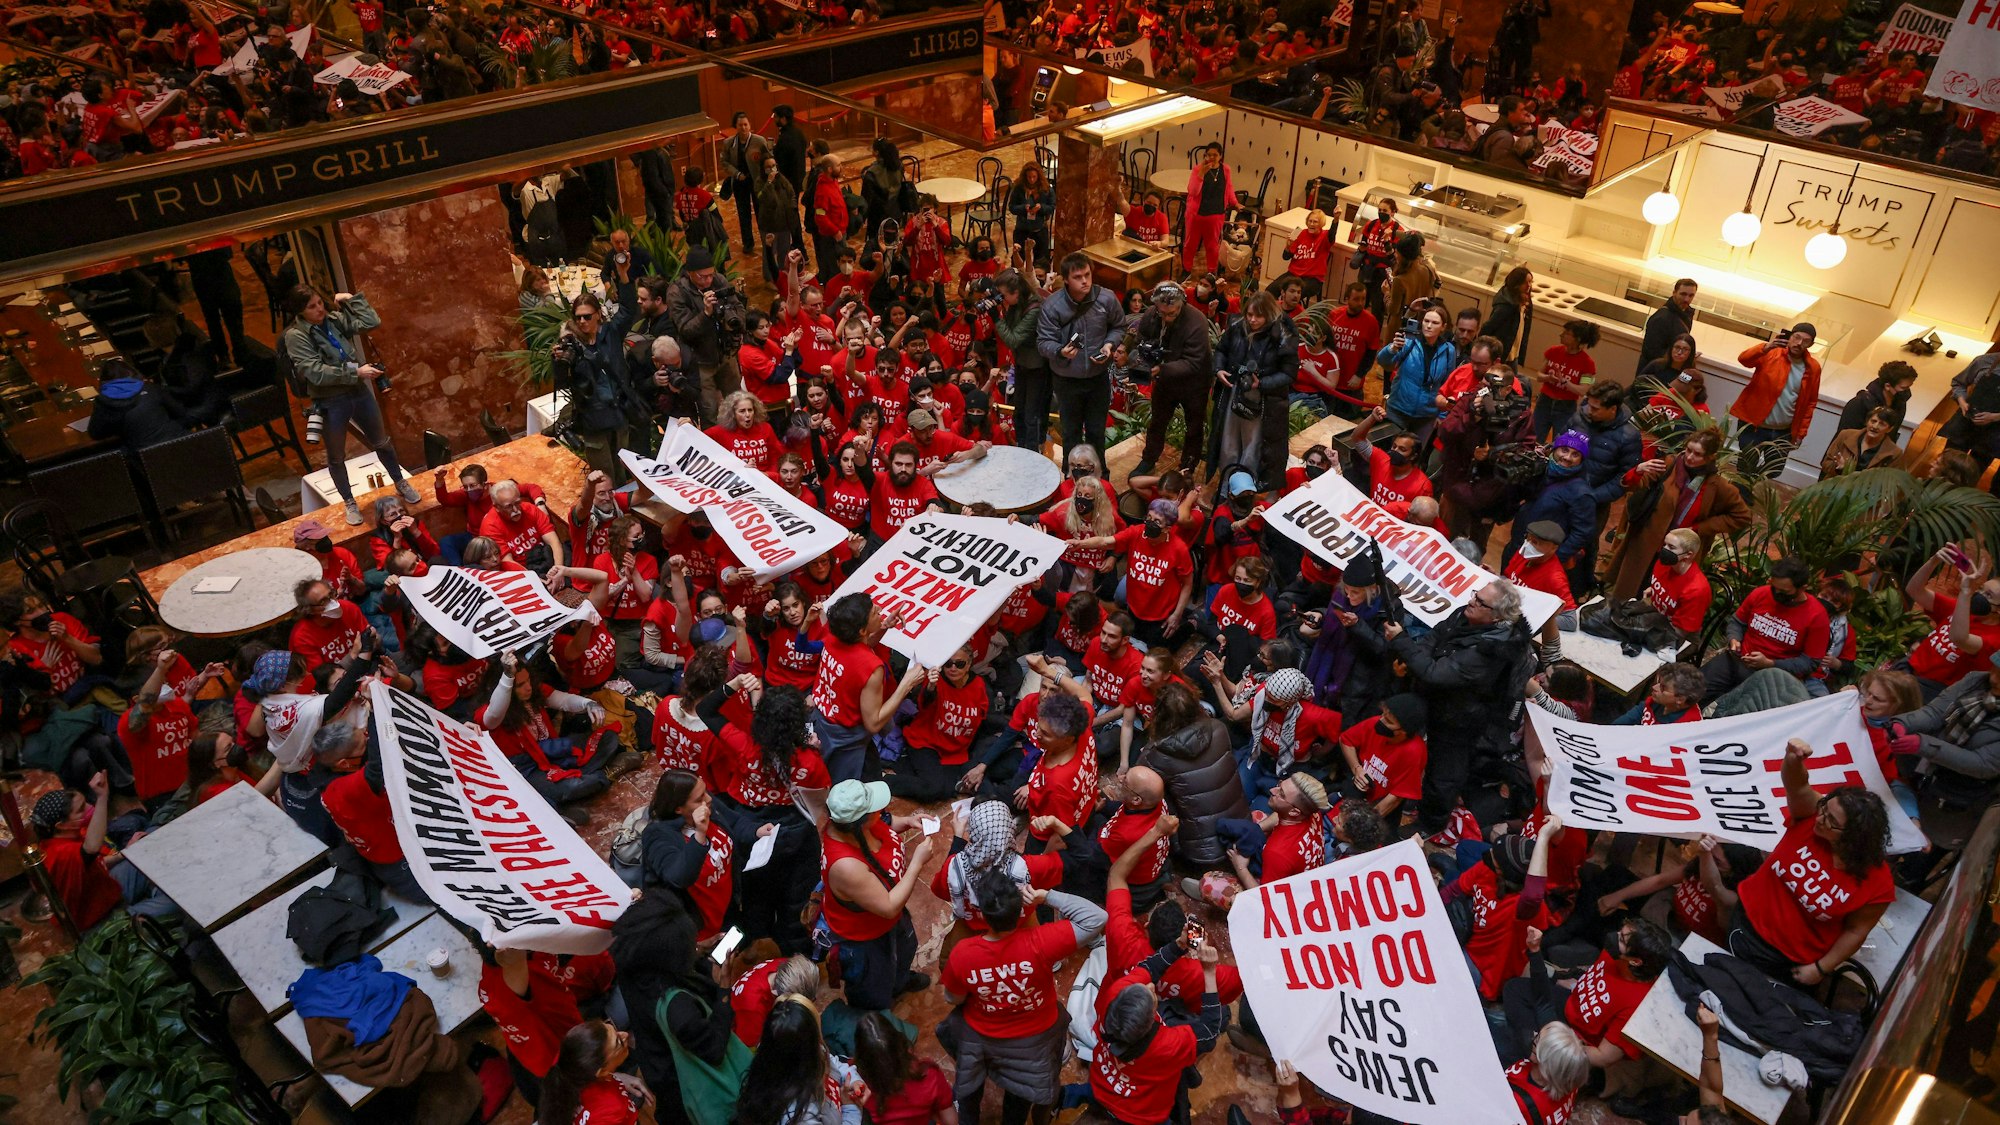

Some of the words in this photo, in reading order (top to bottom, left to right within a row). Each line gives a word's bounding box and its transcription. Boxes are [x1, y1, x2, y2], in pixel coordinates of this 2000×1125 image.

[115, 163, 296, 221] TRUMP
[312, 135, 440, 181] GRILL
[1797, 178, 1904, 215] TRUMP
[947, 331, 971, 340] STOP
[1332, 324, 1350, 335] NOT
[1351, 329, 1361, 338] IN
[1335, 340, 1357, 352] AME
[1568, 368, 1581, 378] IN
[871, 395, 901, 408] STOP
[730, 445, 768, 458] ARMING
[733, 438, 767, 449] STOP
[832, 490, 856, 504] NOT
[859, 497, 870, 507] IN
[908, 497, 920, 506] IN
[1376, 482, 1405, 502] STOP
[890, 507, 916, 517] OUR
[506, 535, 526, 548] NOT
[526, 526, 537, 537] IN
[722, 498, 797, 567] OPPOSIN
[1282, 499, 1371, 560] EPORT
[515, 537, 538, 555] OUR
[909, 522, 1039, 577] STUDENTS
[1340, 499, 1480, 599] MOVEMENT
[902, 545, 998, 587] NOT
[1132, 550, 1156, 566] NOT
[1157, 558, 1169, 569] IN
[1134, 561, 1162, 578] OUR
[874, 559, 978, 612] NAZIS
[1129, 567, 1166, 588] NAME
[421, 568, 495, 627] AGAIN
[1221, 603, 1242, 620] NOT
[1243, 619, 1256, 632] IN
[1753, 613, 1798, 637] DEMOCRATIC
[1750, 618, 1796, 646] SOCIALISTS
[788, 650, 813, 661] OUR
[51, 662, 80, 684] OUR
[456, 667, 484, 687] NOT
[1093, 664, 1124, 685] STOP
[942, 700, 963, 714] NOT
[965, 707, 978, 717] IN
[944, 712, 972, 728] OUR
[660, 722, 702, 754] JEWS
[936, 719, 974, 737] NAME
[1263, 727, 1274, 741] OFF
[1552, 726, 1605, 767] FOR
[1694, 742, 1753, 776] US
[387, 687, 498, 873] MAHMOUD
[1617, 745, 1701, 821] ONE,
[436, 719, 572, 872] PALESTINE
[1705, 785, 1778, 835] FACE
[888, 828, 899, 844] IN
[887, 856, 902, 878] NOT
[1796, 845, 1831, 882] NOT
[1829, 884, 1851, 903] IN
[1771, 859, 1833, 922] NAME
[1789, 862, 1833, 910] OUR
[443, 883, 561, 933] FREE
[520, 872, 620, 930] FREE
[1259, 864, 1427, 939] COMPLY
[1280, 941, 1363, 991] NOT
[1372, 929, 1437, 988] DO
[966, 960, 1035, 985] JEWS
[1595, 960, 1612, 1005] STOP
[977, 976, 1029, 996] SAY
[1340, 990, 1408, 1049] SAY
[1328, 1034, 1440, 1106] JEWS
